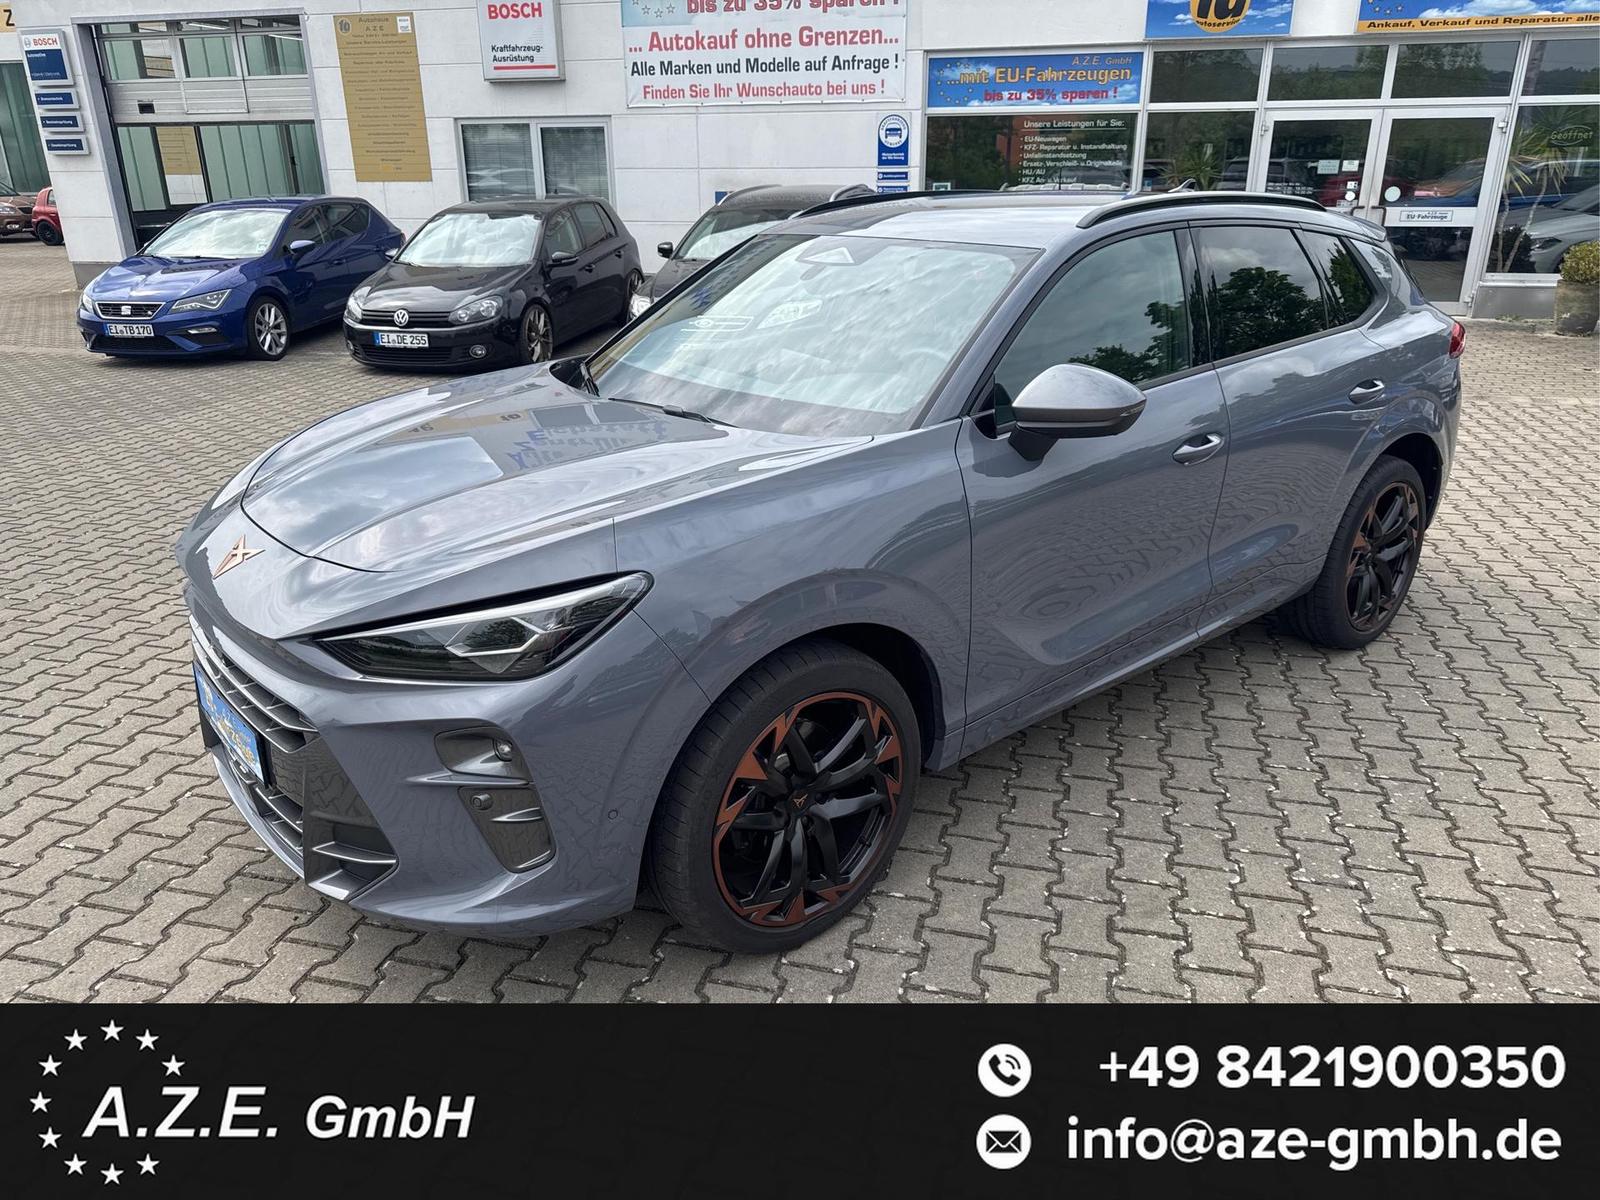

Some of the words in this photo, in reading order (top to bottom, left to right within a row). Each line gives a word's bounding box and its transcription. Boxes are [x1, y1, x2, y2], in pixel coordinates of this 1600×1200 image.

[488, 2, 542, 19] BOSCH
[723, 0, 746, 12] zu
[1420, 18, 1472, 27] Verkauf
[1475, 17, 1499, 25] und
[1503, 16, 1572, 25] Reparatur
[32, 37, 58, 46] BOSCH
[648, 28, 738, 52] Autokauf
[744, 27, 792, 49] ohne
[798, 25, 899, 47] Grenzen...
[491, 44, 543, 53] Kraftfahrzeug-
[492, 54, 535, 63] Ausrüstung
[1105, 56, 1132, 65] GmbH
[631, 61, 655, 76] Alle
[660, 60, 712, 75] Marken
[716, 58, 741, 74] und
[745, 56, 800, 73] Modelle
[805, 55, 827, 72] auf
[831, 54, 890, 74] Anfrage
[894, 53, 899, 69] !
[995, 67, 1131, 85] EU-Fahrzeugen
[643, 84, 685, 100] Finden
[689, 83, 710, 98] Sie
[714, 82, 732, 98] Ihr
[736, 81, 822, 97] Wunschauto
[827, 80, 847, 95] bei
[851, 82, 876, 95] uns
[881, 79, 885, 94] !
[984, 90, 1003, 101] bis
[1007, 91, 1022, 101] zu
[1027, 89, 1056, 101] 35%
[1061, 89, 1108, 103] sparen
[1023, 119, 1051, 128] Unsere
[1053, 119, 1094, 129] Leistungen
[1096, 118, 1108, 127] für
[1080, 142, 1128, 151] Instandhaltung
